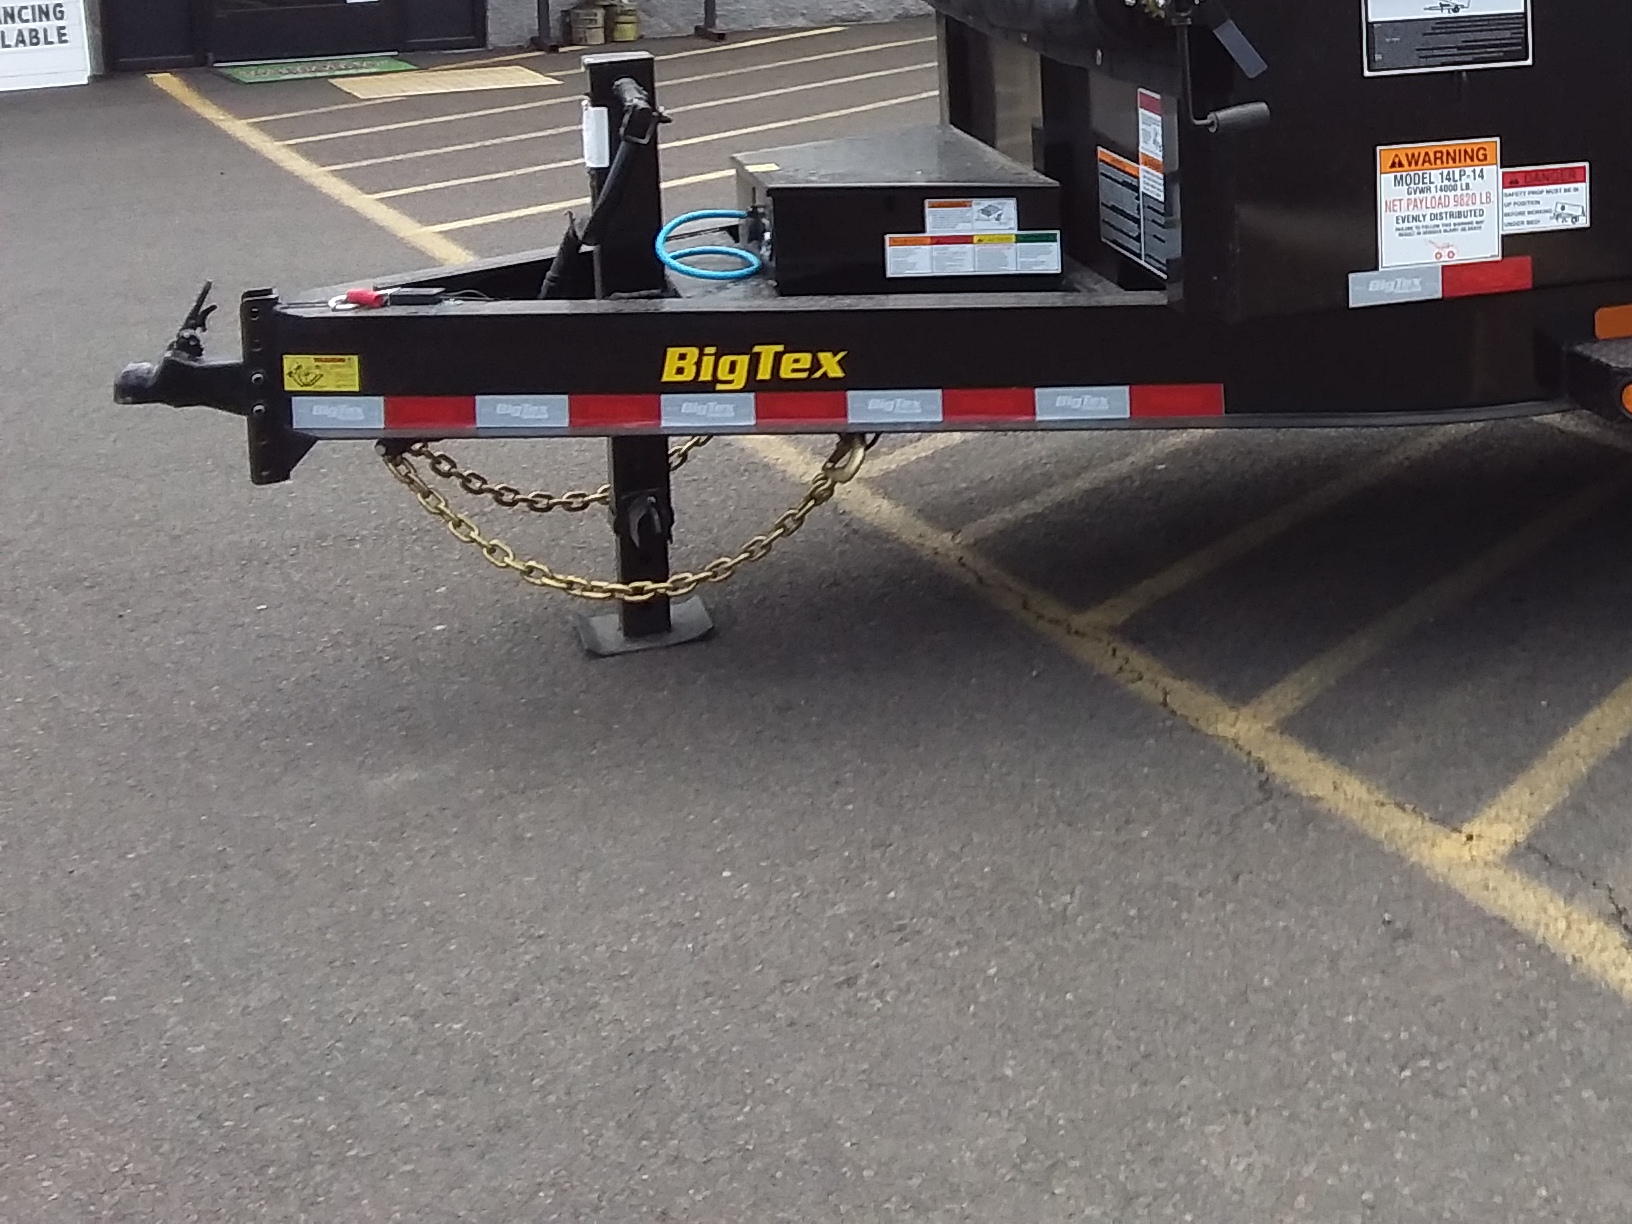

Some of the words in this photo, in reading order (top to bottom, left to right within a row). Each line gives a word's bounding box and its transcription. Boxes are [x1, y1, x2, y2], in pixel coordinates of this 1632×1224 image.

[0, 2, 65, 25] NCING
[0, 25, 69, 49] LABLE
[1404, 146, 1489, 168] WARNING
[1393, 172, 1435, 188] MODEL
[1438, 167, 1485, 184] 14LP-14
[1406, 185, 1432, 196] GVWR
[1434, 183, 1458, 193] 14000
[1384, 198, 1404, 213] NET
[1406, 194, 1451, 211] PAYLOAD
[1395, 212, 1428, 225] EVENLY
[1429, 208, 1485, 222] DISTRIBUTED
[660, 344, 849, 391] BigTex
